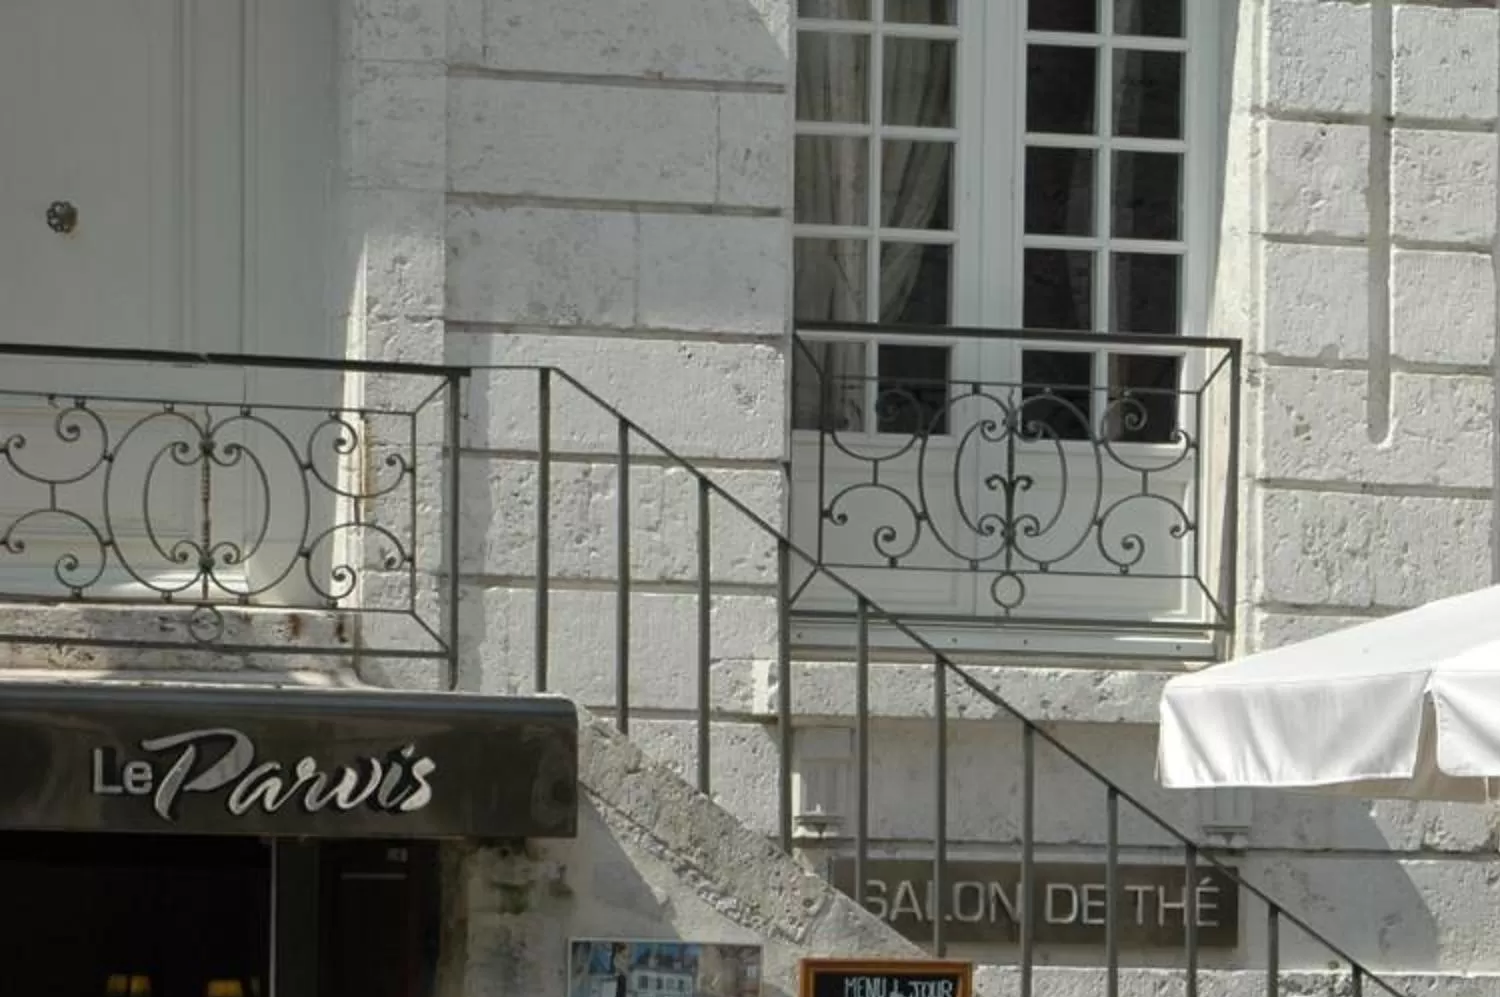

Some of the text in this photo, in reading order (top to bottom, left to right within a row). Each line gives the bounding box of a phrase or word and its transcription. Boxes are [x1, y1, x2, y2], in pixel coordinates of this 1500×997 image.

[93, 728, 437, 825] Le Parvis
[1044, 882, 1107, 927] DE
[1124, 876, 1220, 928] THÉ
